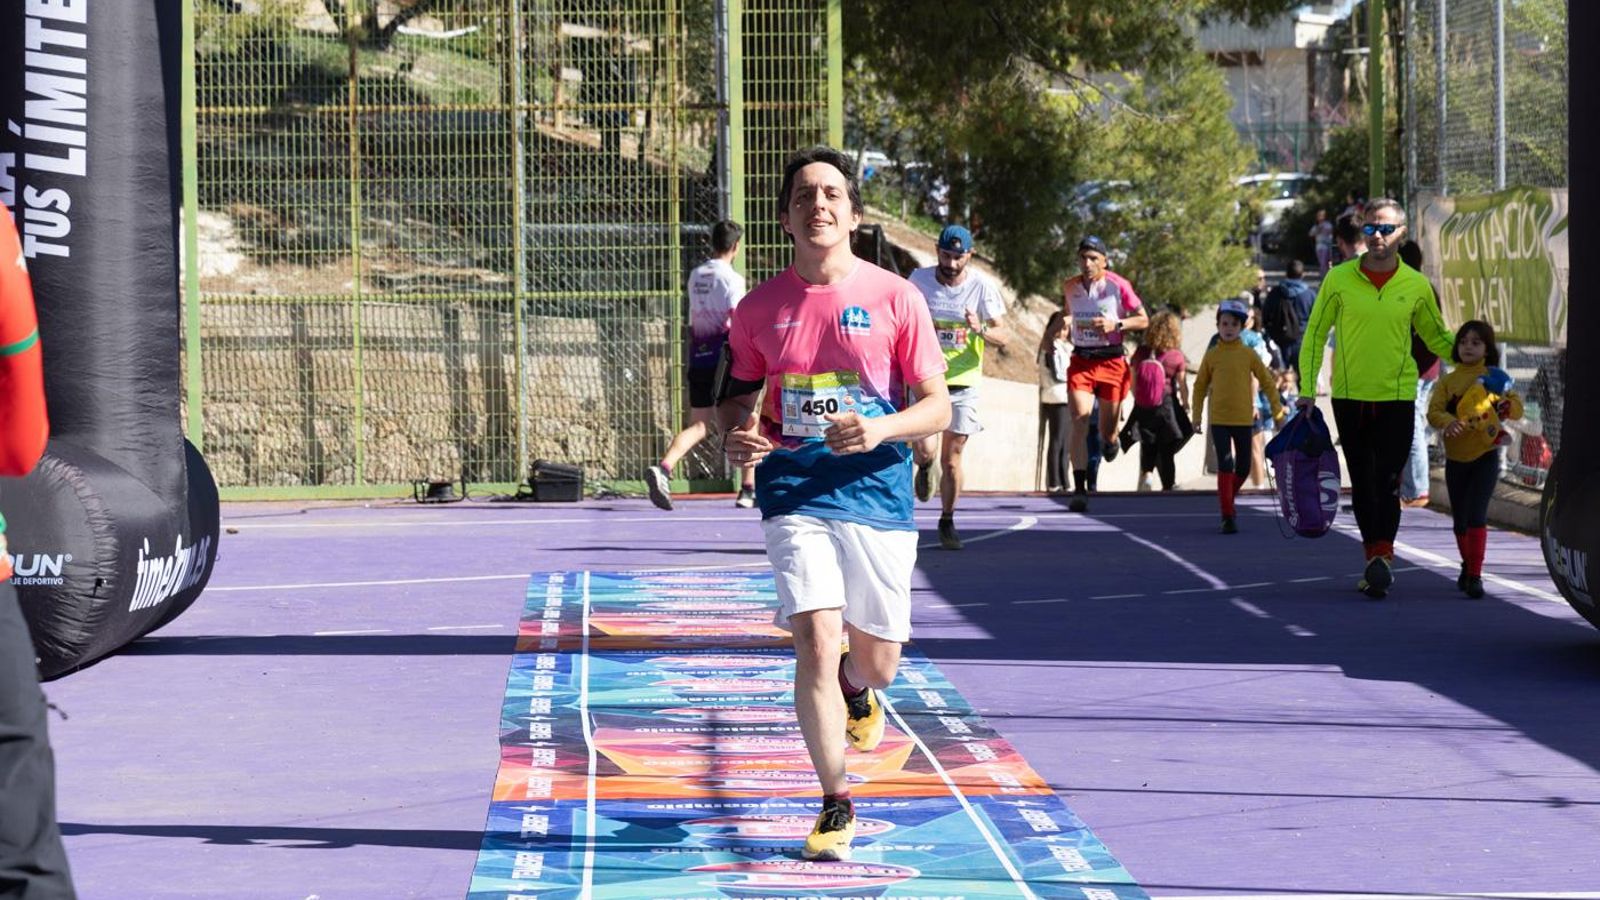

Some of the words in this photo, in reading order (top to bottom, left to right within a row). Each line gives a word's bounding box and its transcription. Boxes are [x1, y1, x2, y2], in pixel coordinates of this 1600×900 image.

[23, 186, 72, 258] TUS
[801, 398, 838, 416] 450
[23, 577, 64, 586] DEPORTIVO
